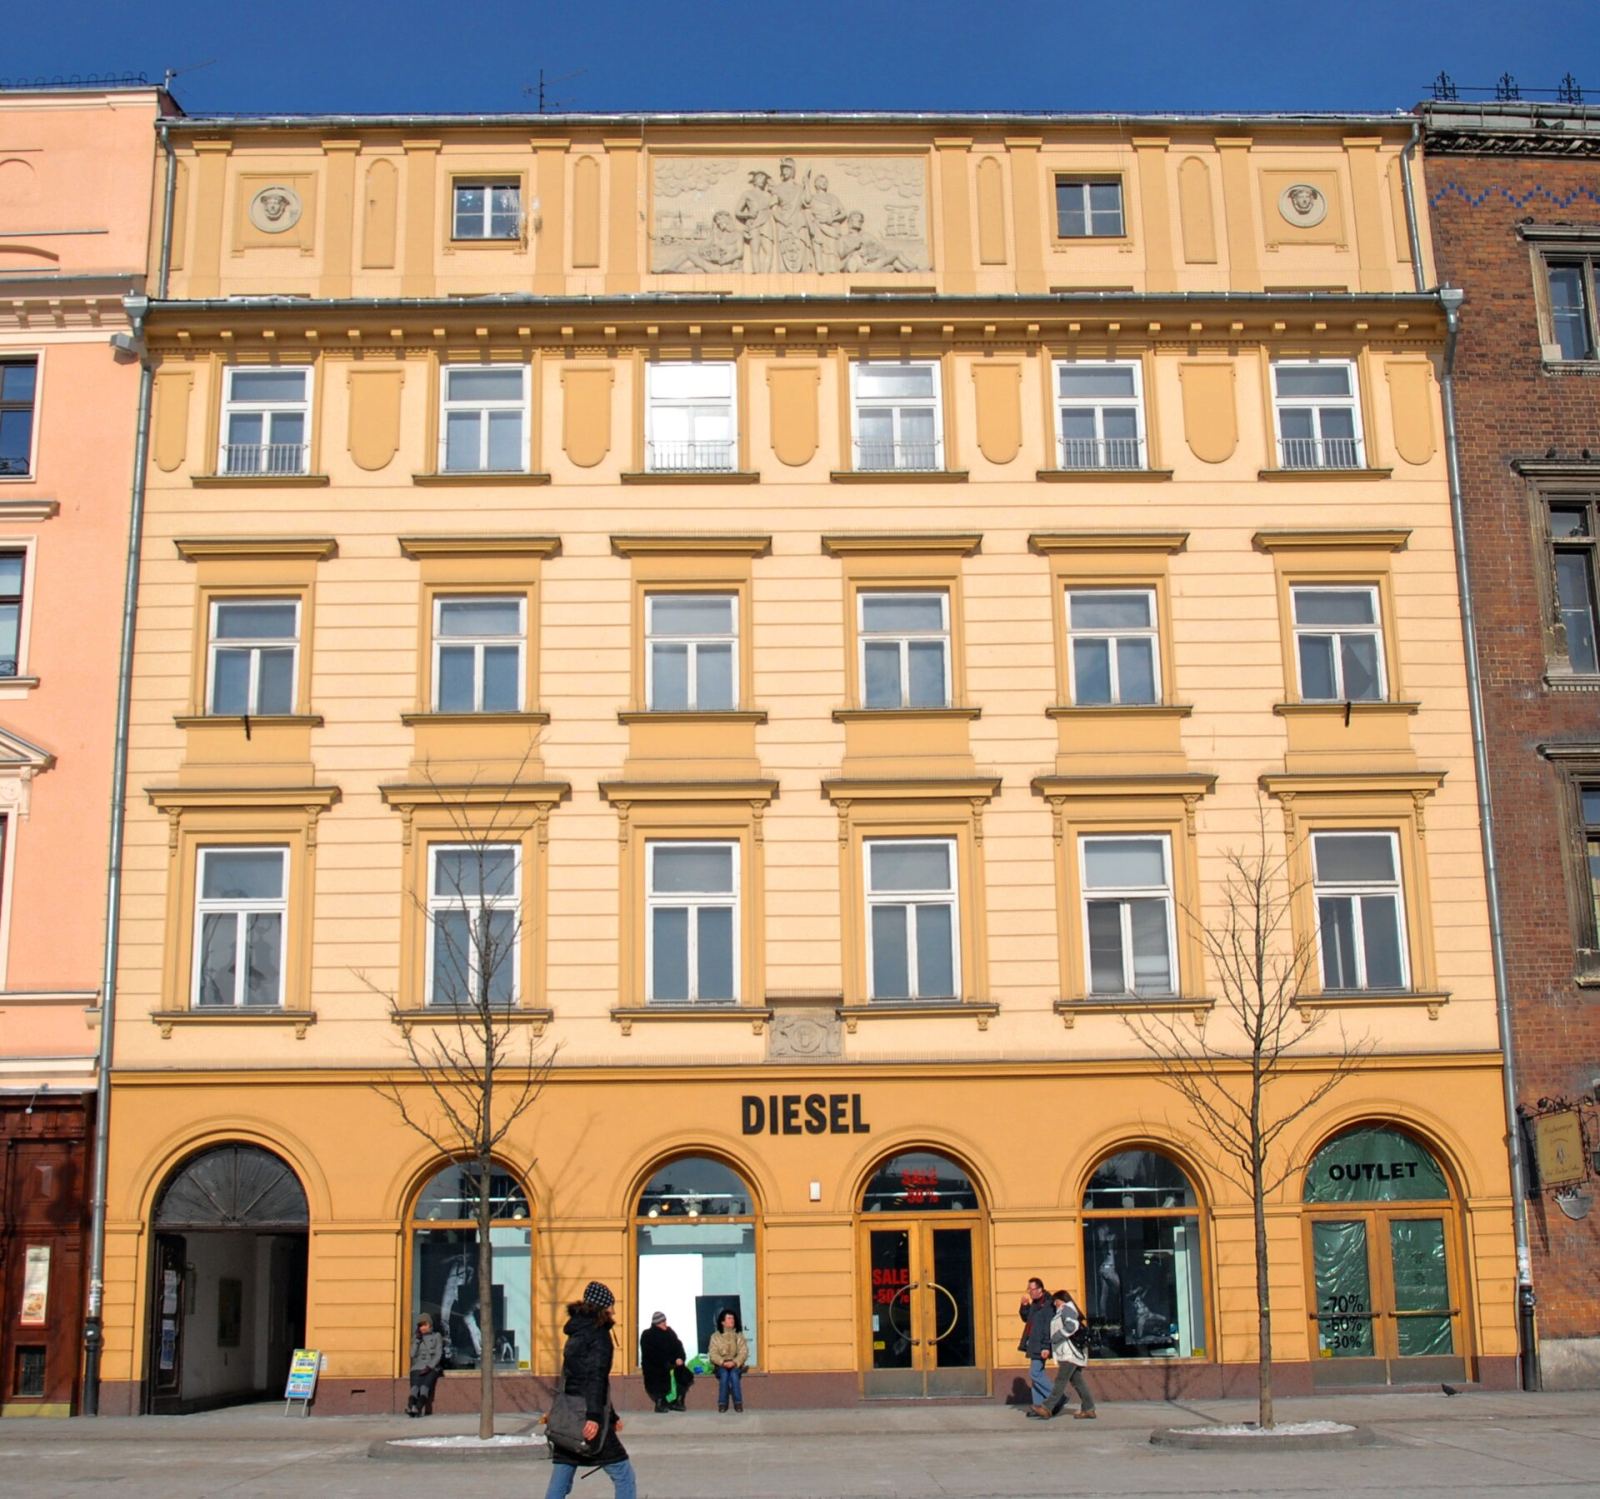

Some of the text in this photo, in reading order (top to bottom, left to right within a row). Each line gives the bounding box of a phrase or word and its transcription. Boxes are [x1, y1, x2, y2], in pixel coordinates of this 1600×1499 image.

[742, 1093, 870, 1135] DIESEL
[901, 1167, 938, 1185] SALE
[1329, 1162, 1418, 1181] OUTLET
[873, 1268, 908, 1285] SALE
[1323, 1294, 1364, 1313] -70%
[1328, 1335, 1362, 1349] -30%
